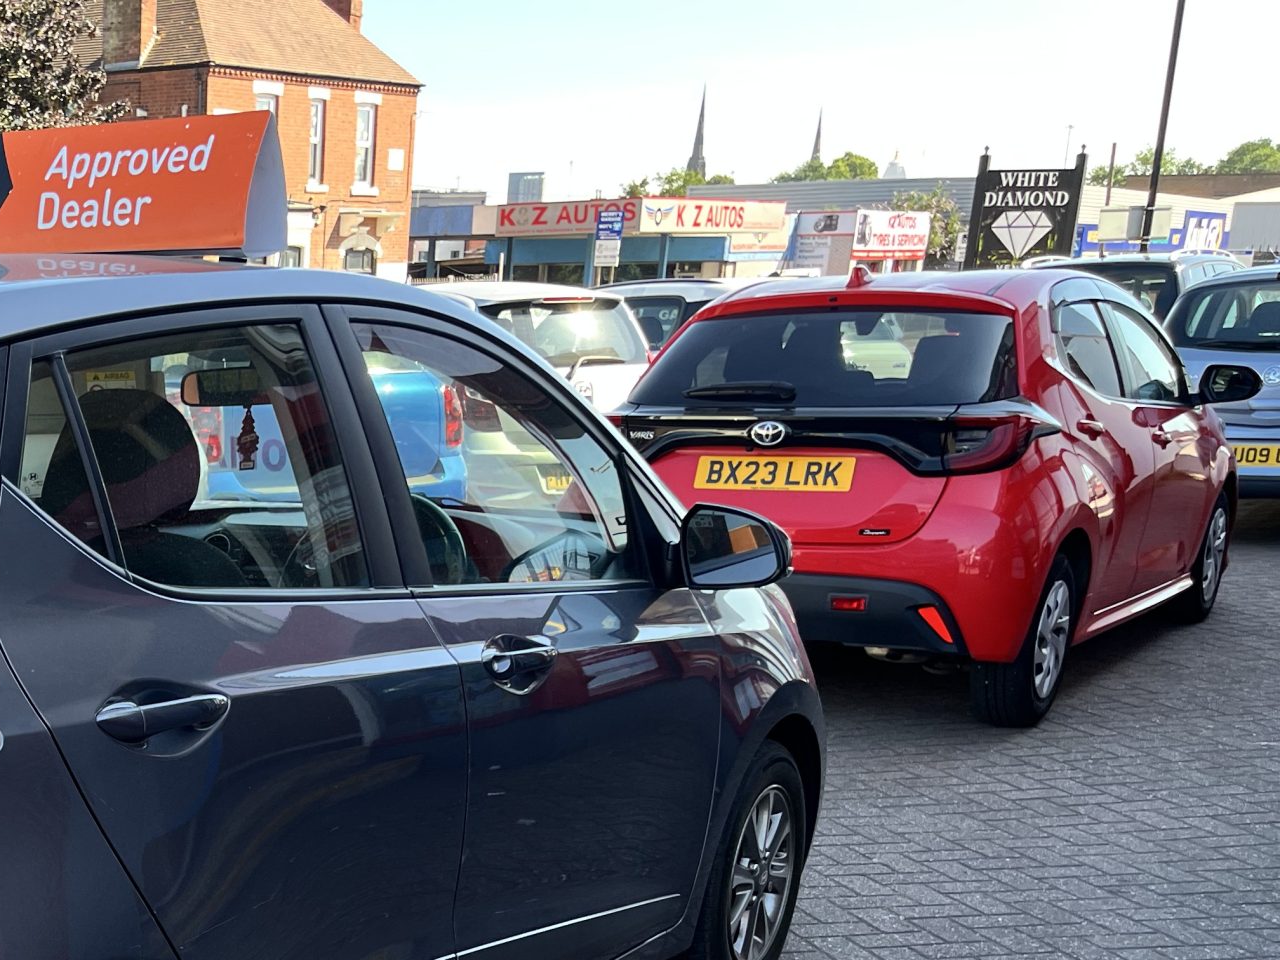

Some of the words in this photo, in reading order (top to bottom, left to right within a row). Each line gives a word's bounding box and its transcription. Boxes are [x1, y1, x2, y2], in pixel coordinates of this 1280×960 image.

[44, 133, 216, 190] Approved
[1000, 171, 1060, 188] WHITE
[983, 190, 1070, 208] DIAMOND
[37, 188, 153, 231] Dealer
[705, 205, 745, 228] AUTOS
[629, 431, 655, 441] YARIS
[1234, 447, 1271, 463] U09
[705, 460, 779, 485] BX23
[784, 460, 843, 487] LRK
